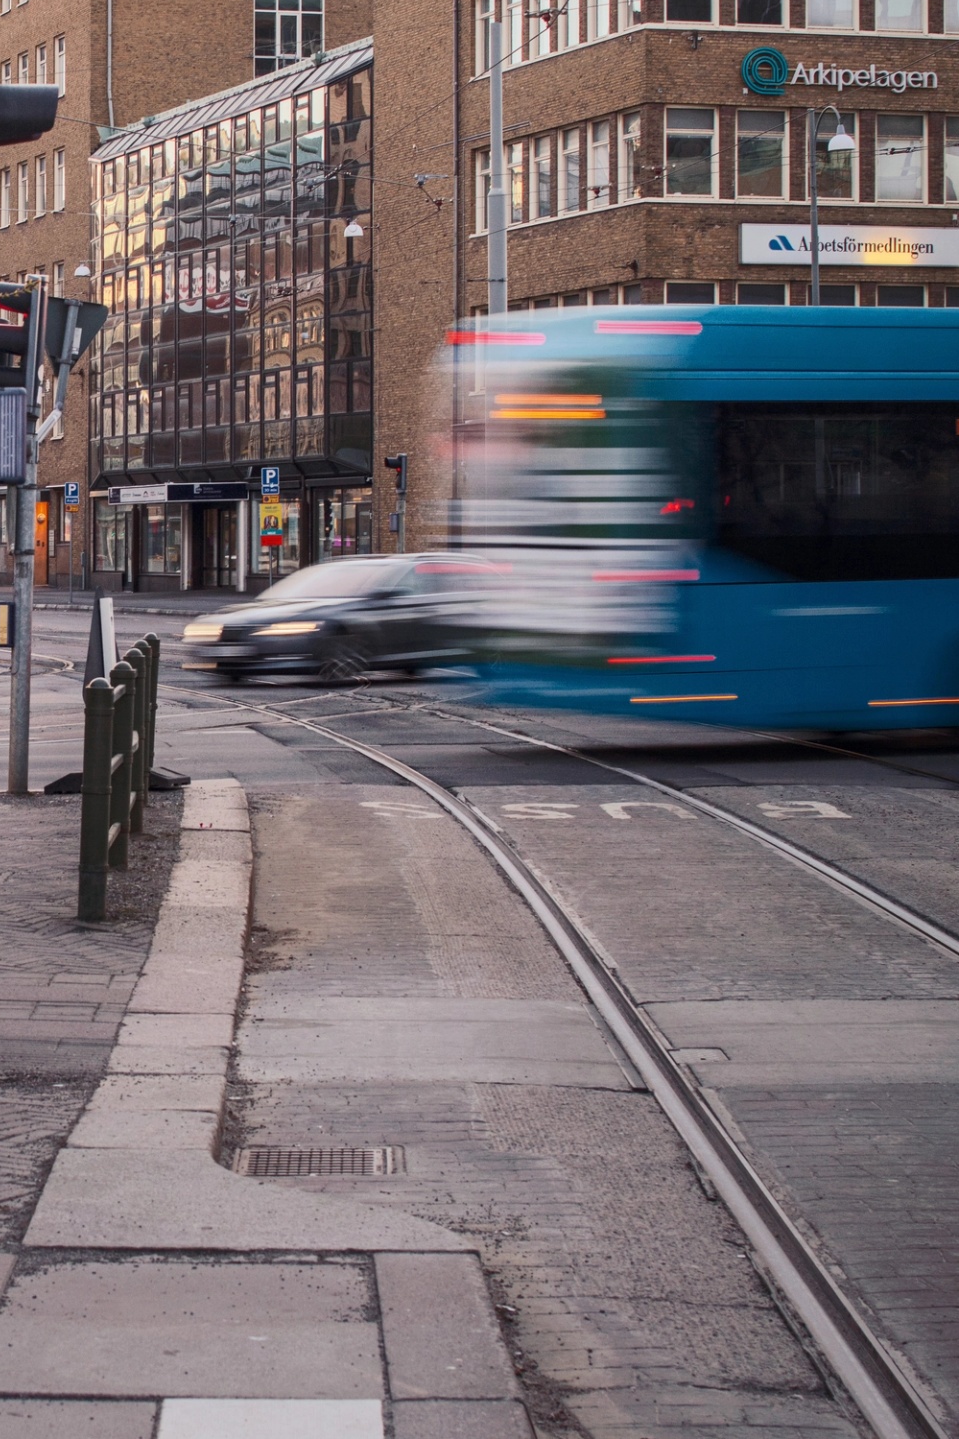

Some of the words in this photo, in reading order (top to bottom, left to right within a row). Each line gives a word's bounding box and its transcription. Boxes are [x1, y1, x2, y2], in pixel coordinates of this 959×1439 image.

[790, 62, 938, 93] Arkipelagen
[266, 469, 276, 484] P
[68, 483, 77, 496] P
[358, 800, 853, 819] BUSS
